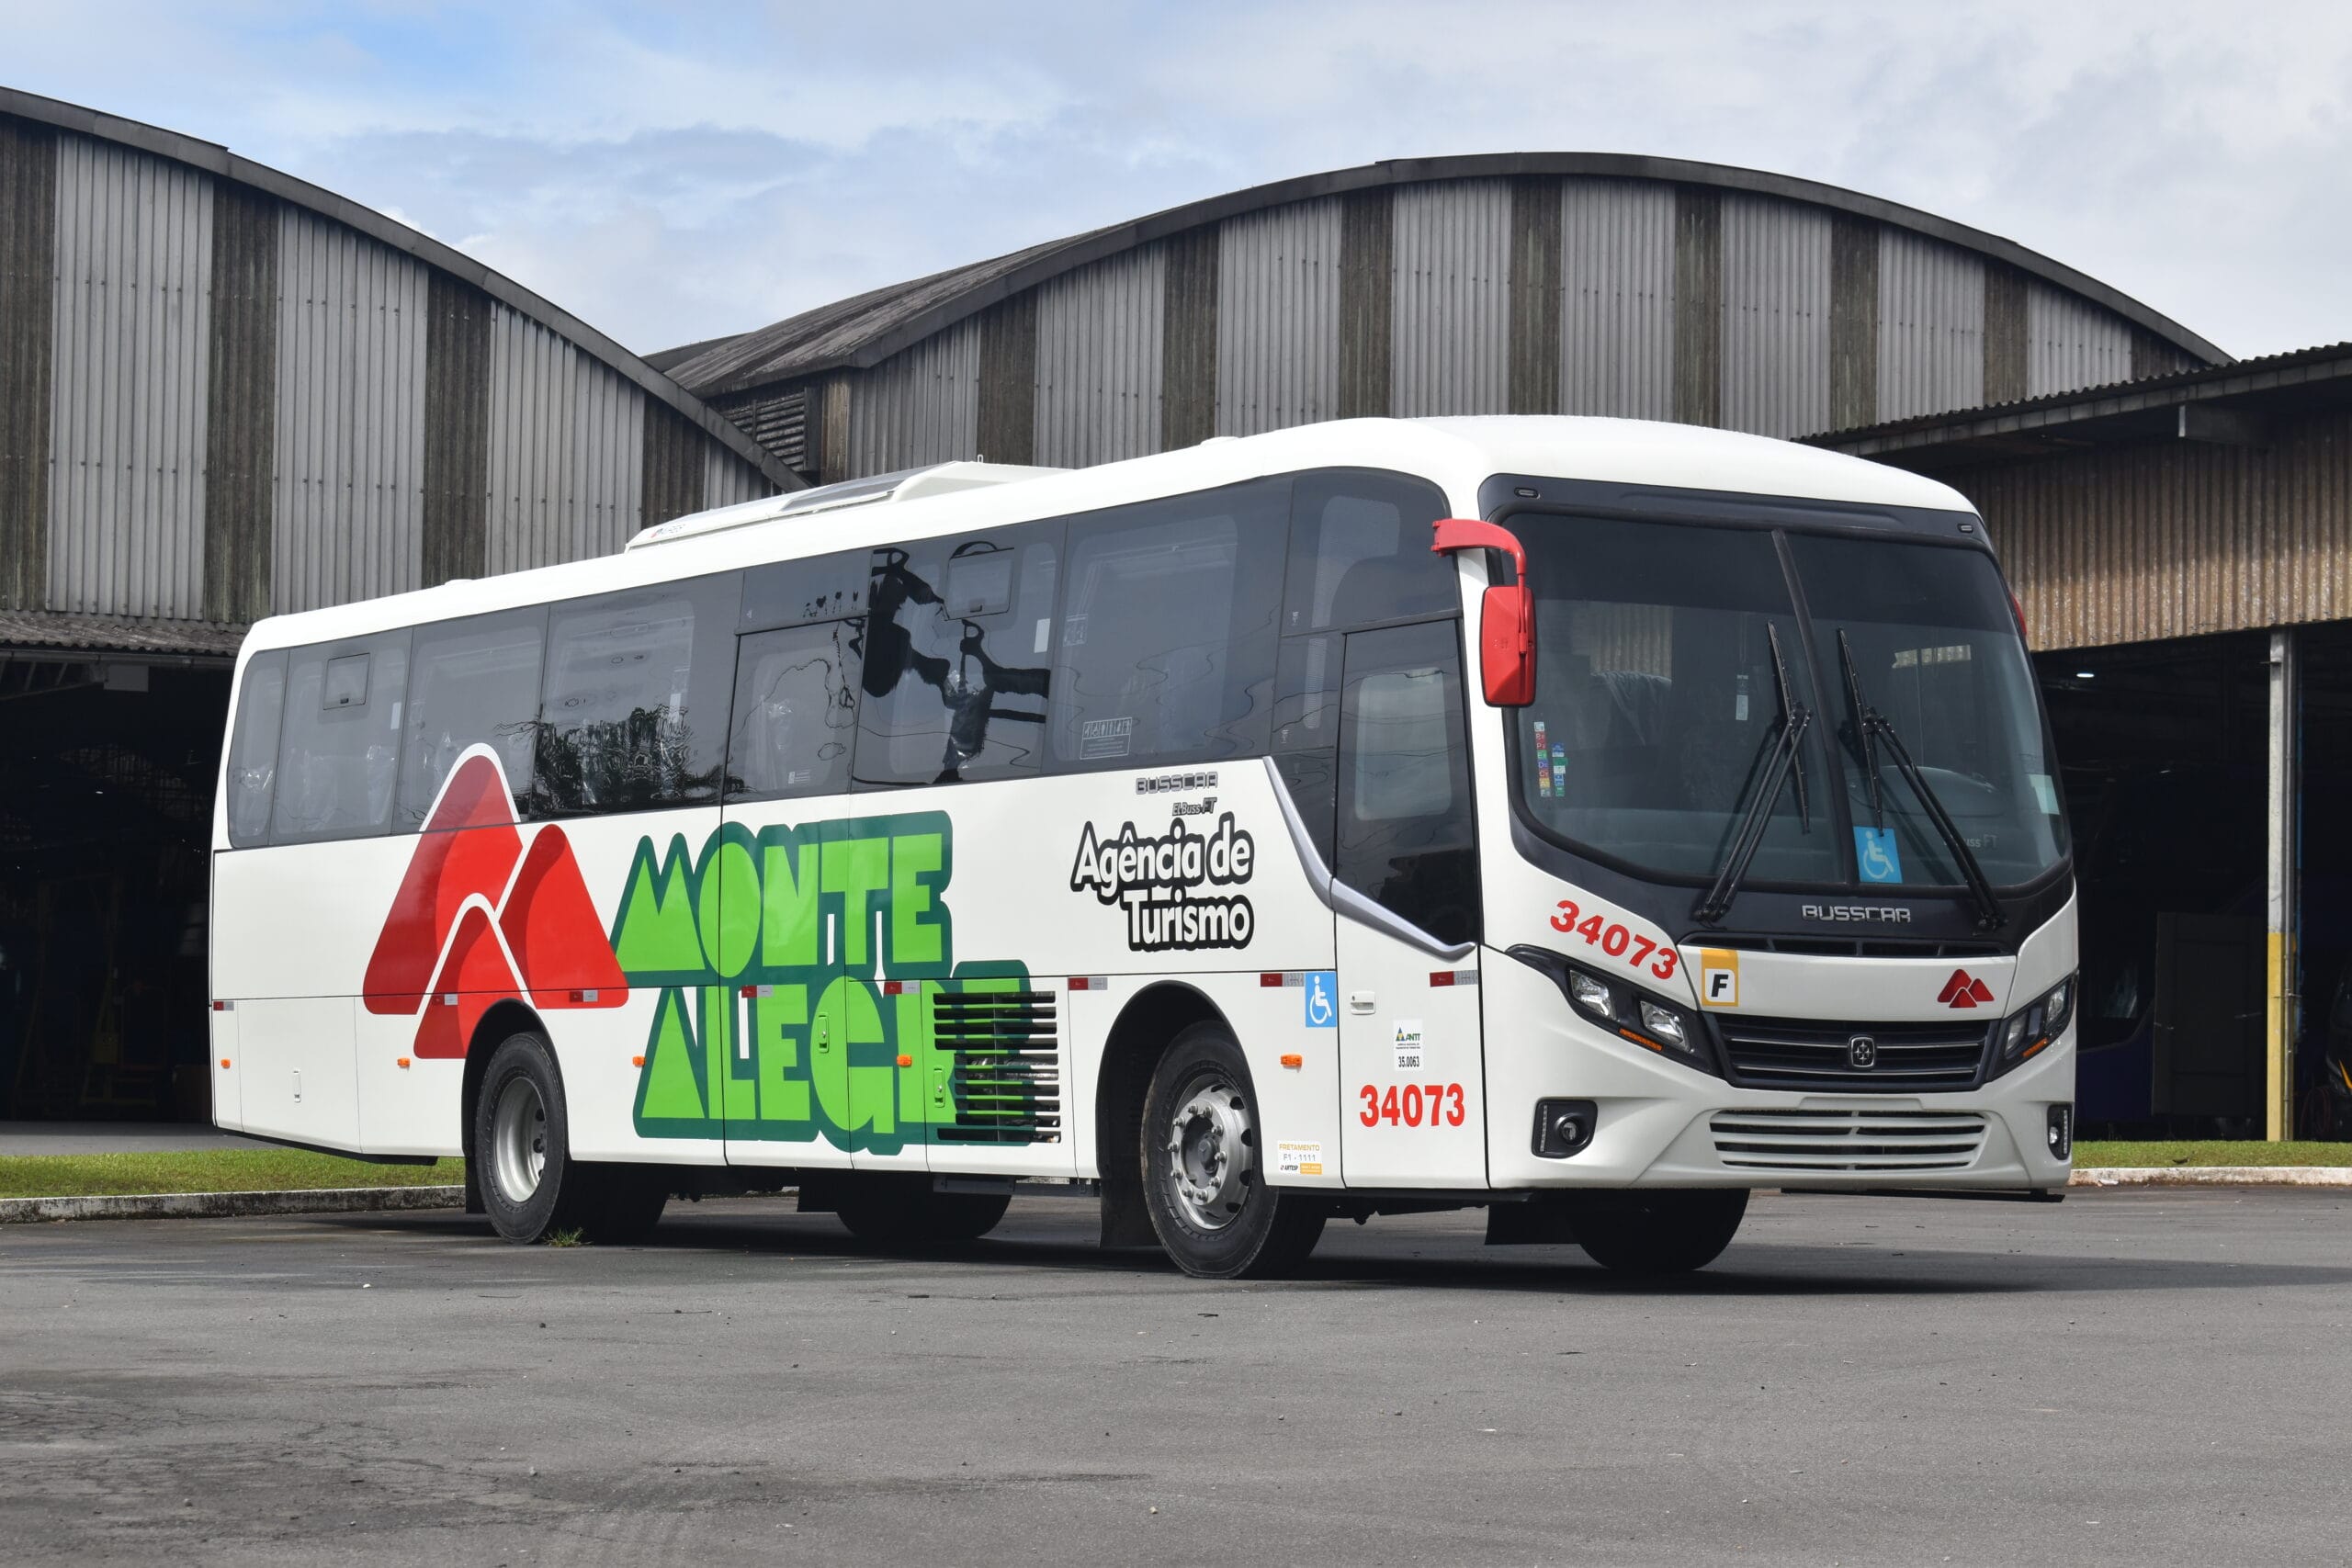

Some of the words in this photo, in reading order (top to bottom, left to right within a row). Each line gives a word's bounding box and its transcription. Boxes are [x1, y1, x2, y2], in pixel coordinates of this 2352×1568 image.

[1136, 772, 1218, 795] BUSSCAR
[1202, 796, 1217, 814] FT
[1071, 822, 1203, 900] Agência
[1208, 816, 1252, 881] de
[613, 829, 944, 979] MONTE
[1122, 888, 1252, 946] Turismo
[1802, 905, 1911, 922] BUSSCAR
[1550, 899, 1678, 980] 34073
[1711, 974, 1728, 998] F
[1360, 1083, 1464, 1127] 34073
